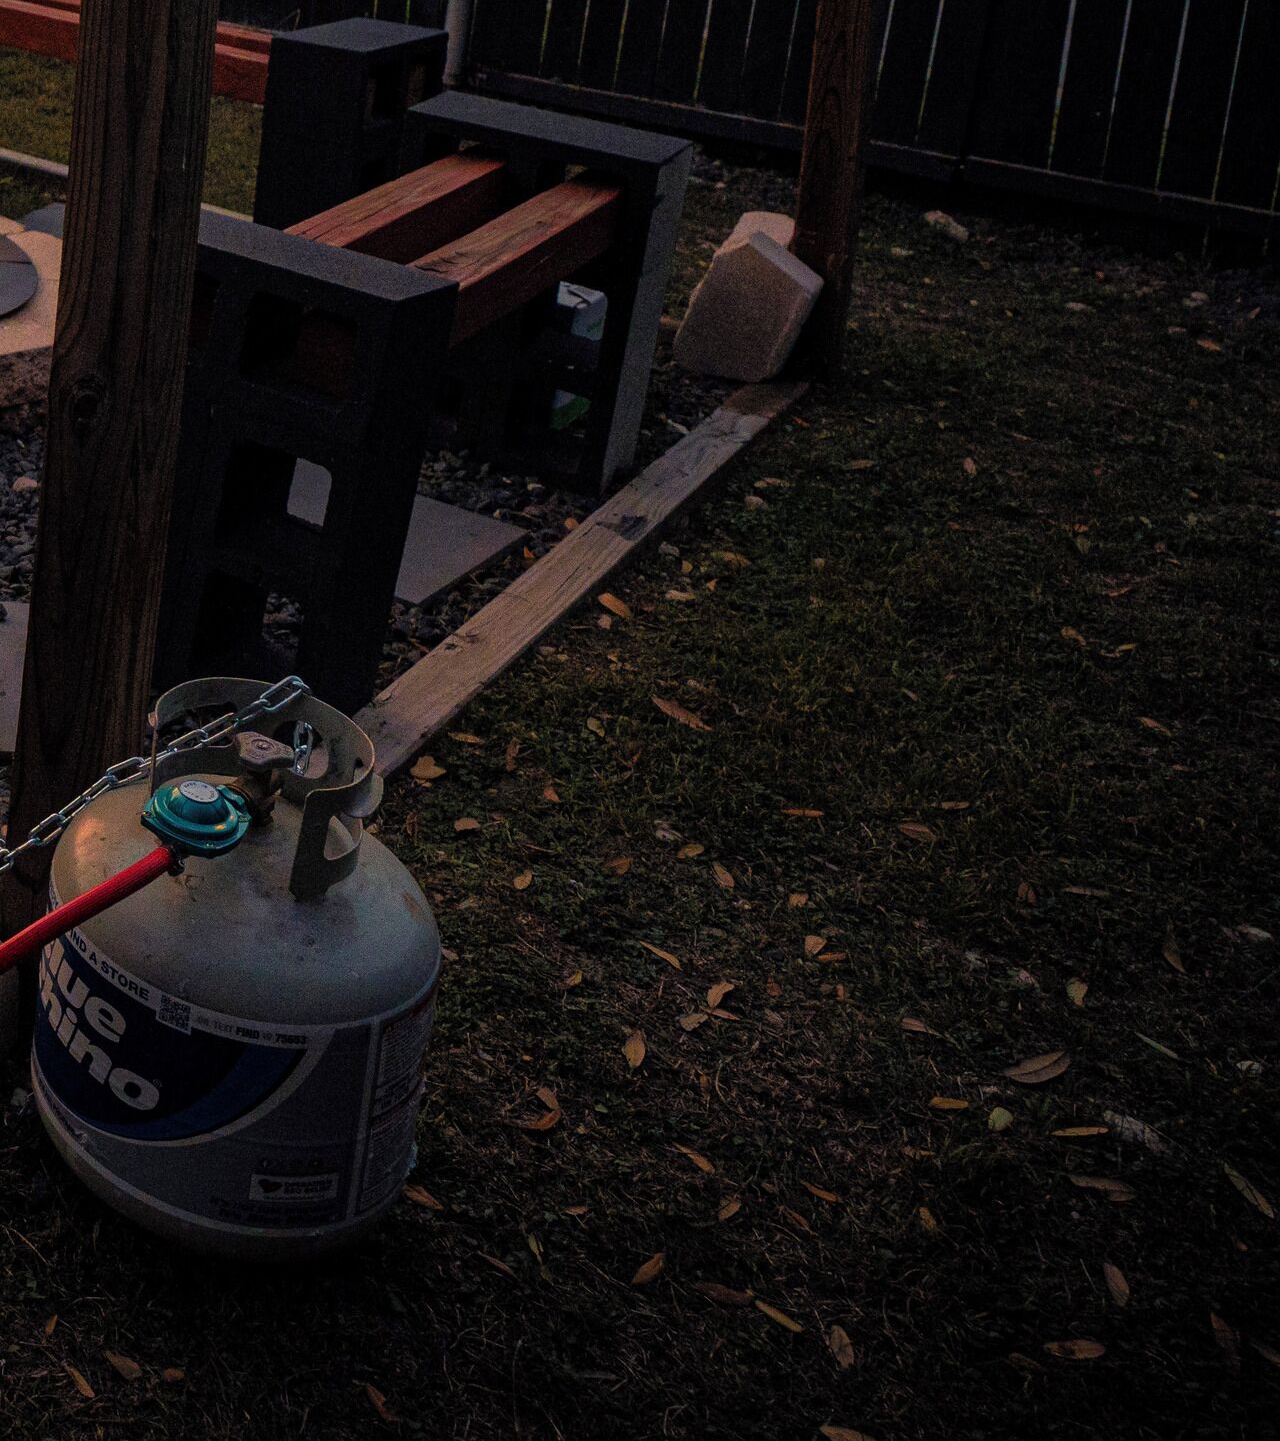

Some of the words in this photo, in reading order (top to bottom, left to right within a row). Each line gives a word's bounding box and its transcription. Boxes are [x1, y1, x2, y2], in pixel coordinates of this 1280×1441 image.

[88, 952, 98, 967] A
[100, 960, 150, 1000] STORE
[235, 1026, 260, 1039] FIND
